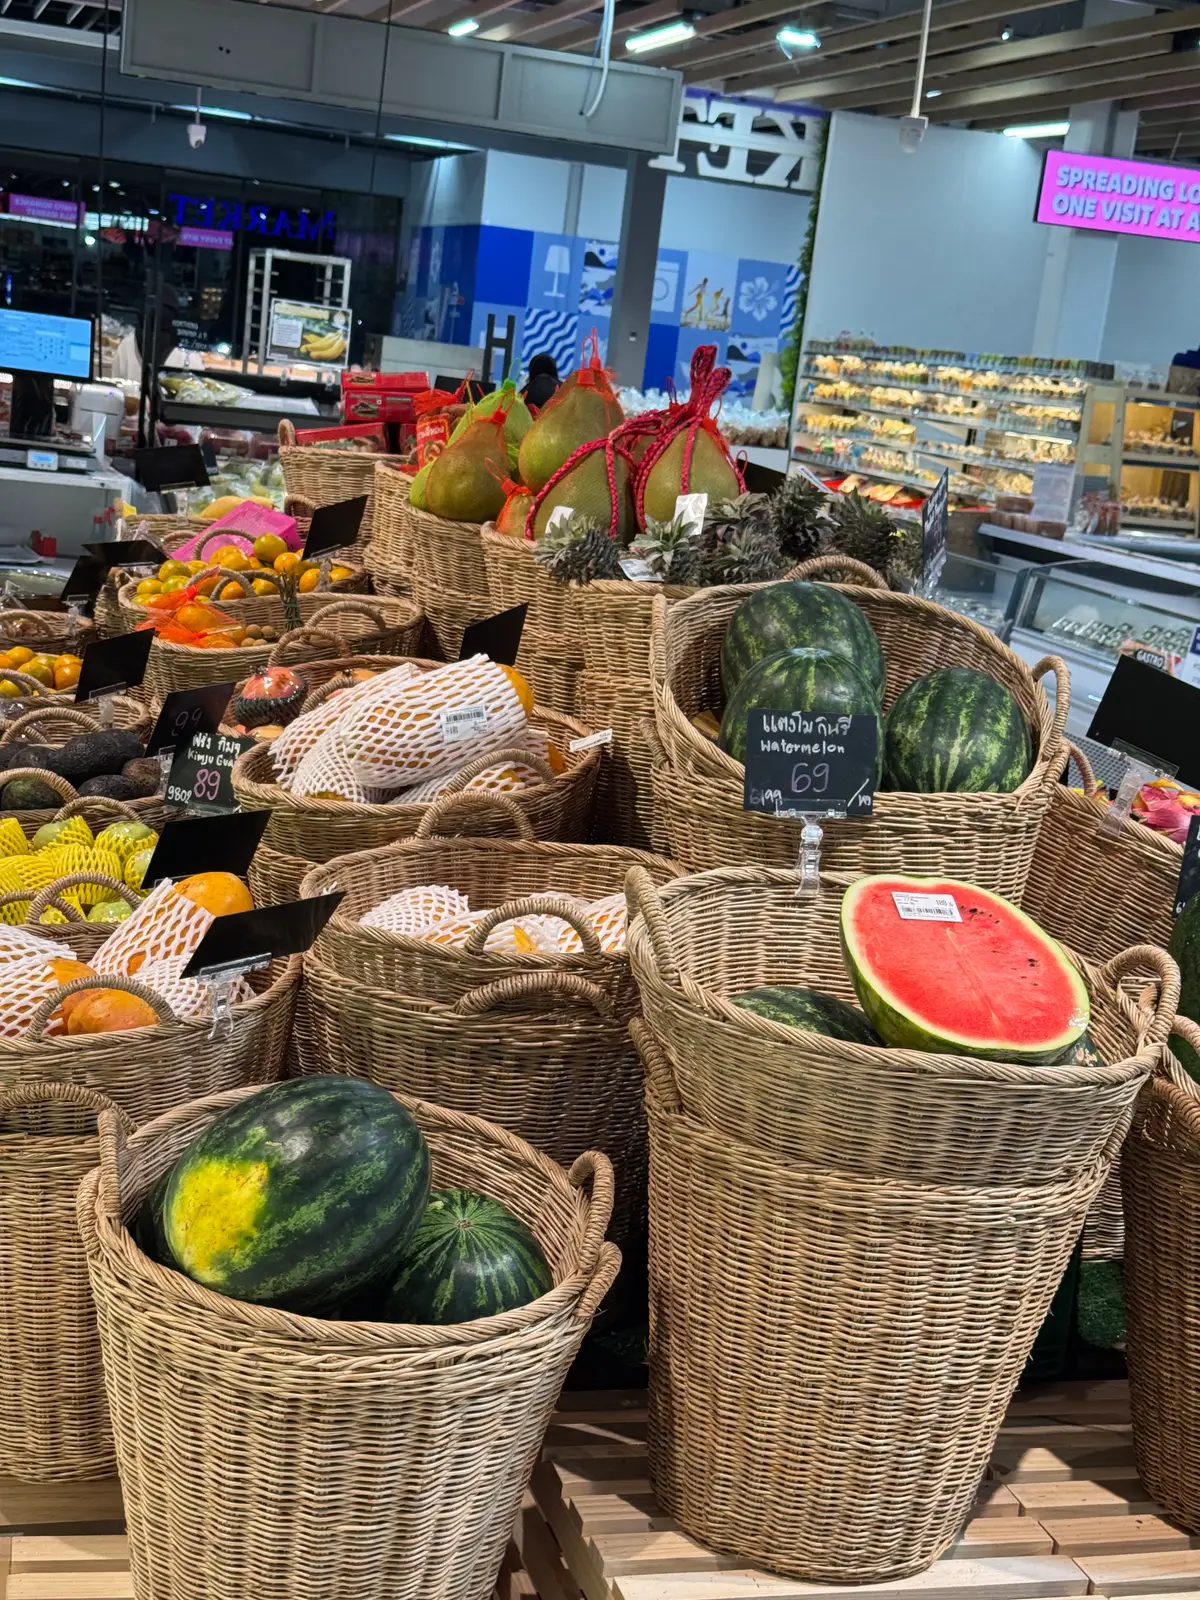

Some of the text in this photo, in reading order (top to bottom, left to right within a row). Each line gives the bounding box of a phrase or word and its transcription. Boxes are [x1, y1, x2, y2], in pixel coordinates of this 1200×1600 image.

[1056, 165, 1175, 200] SPREADING
[1052, 192, 1097, 218] ONE
[1101, 200, 1153, 225] VISIT
[1155, 207, 1184, 230] AT
[762, 711, 813, 734] แตงโม
[194, 768, 221, 801] 89
[791, 762, 830, 793] 69
